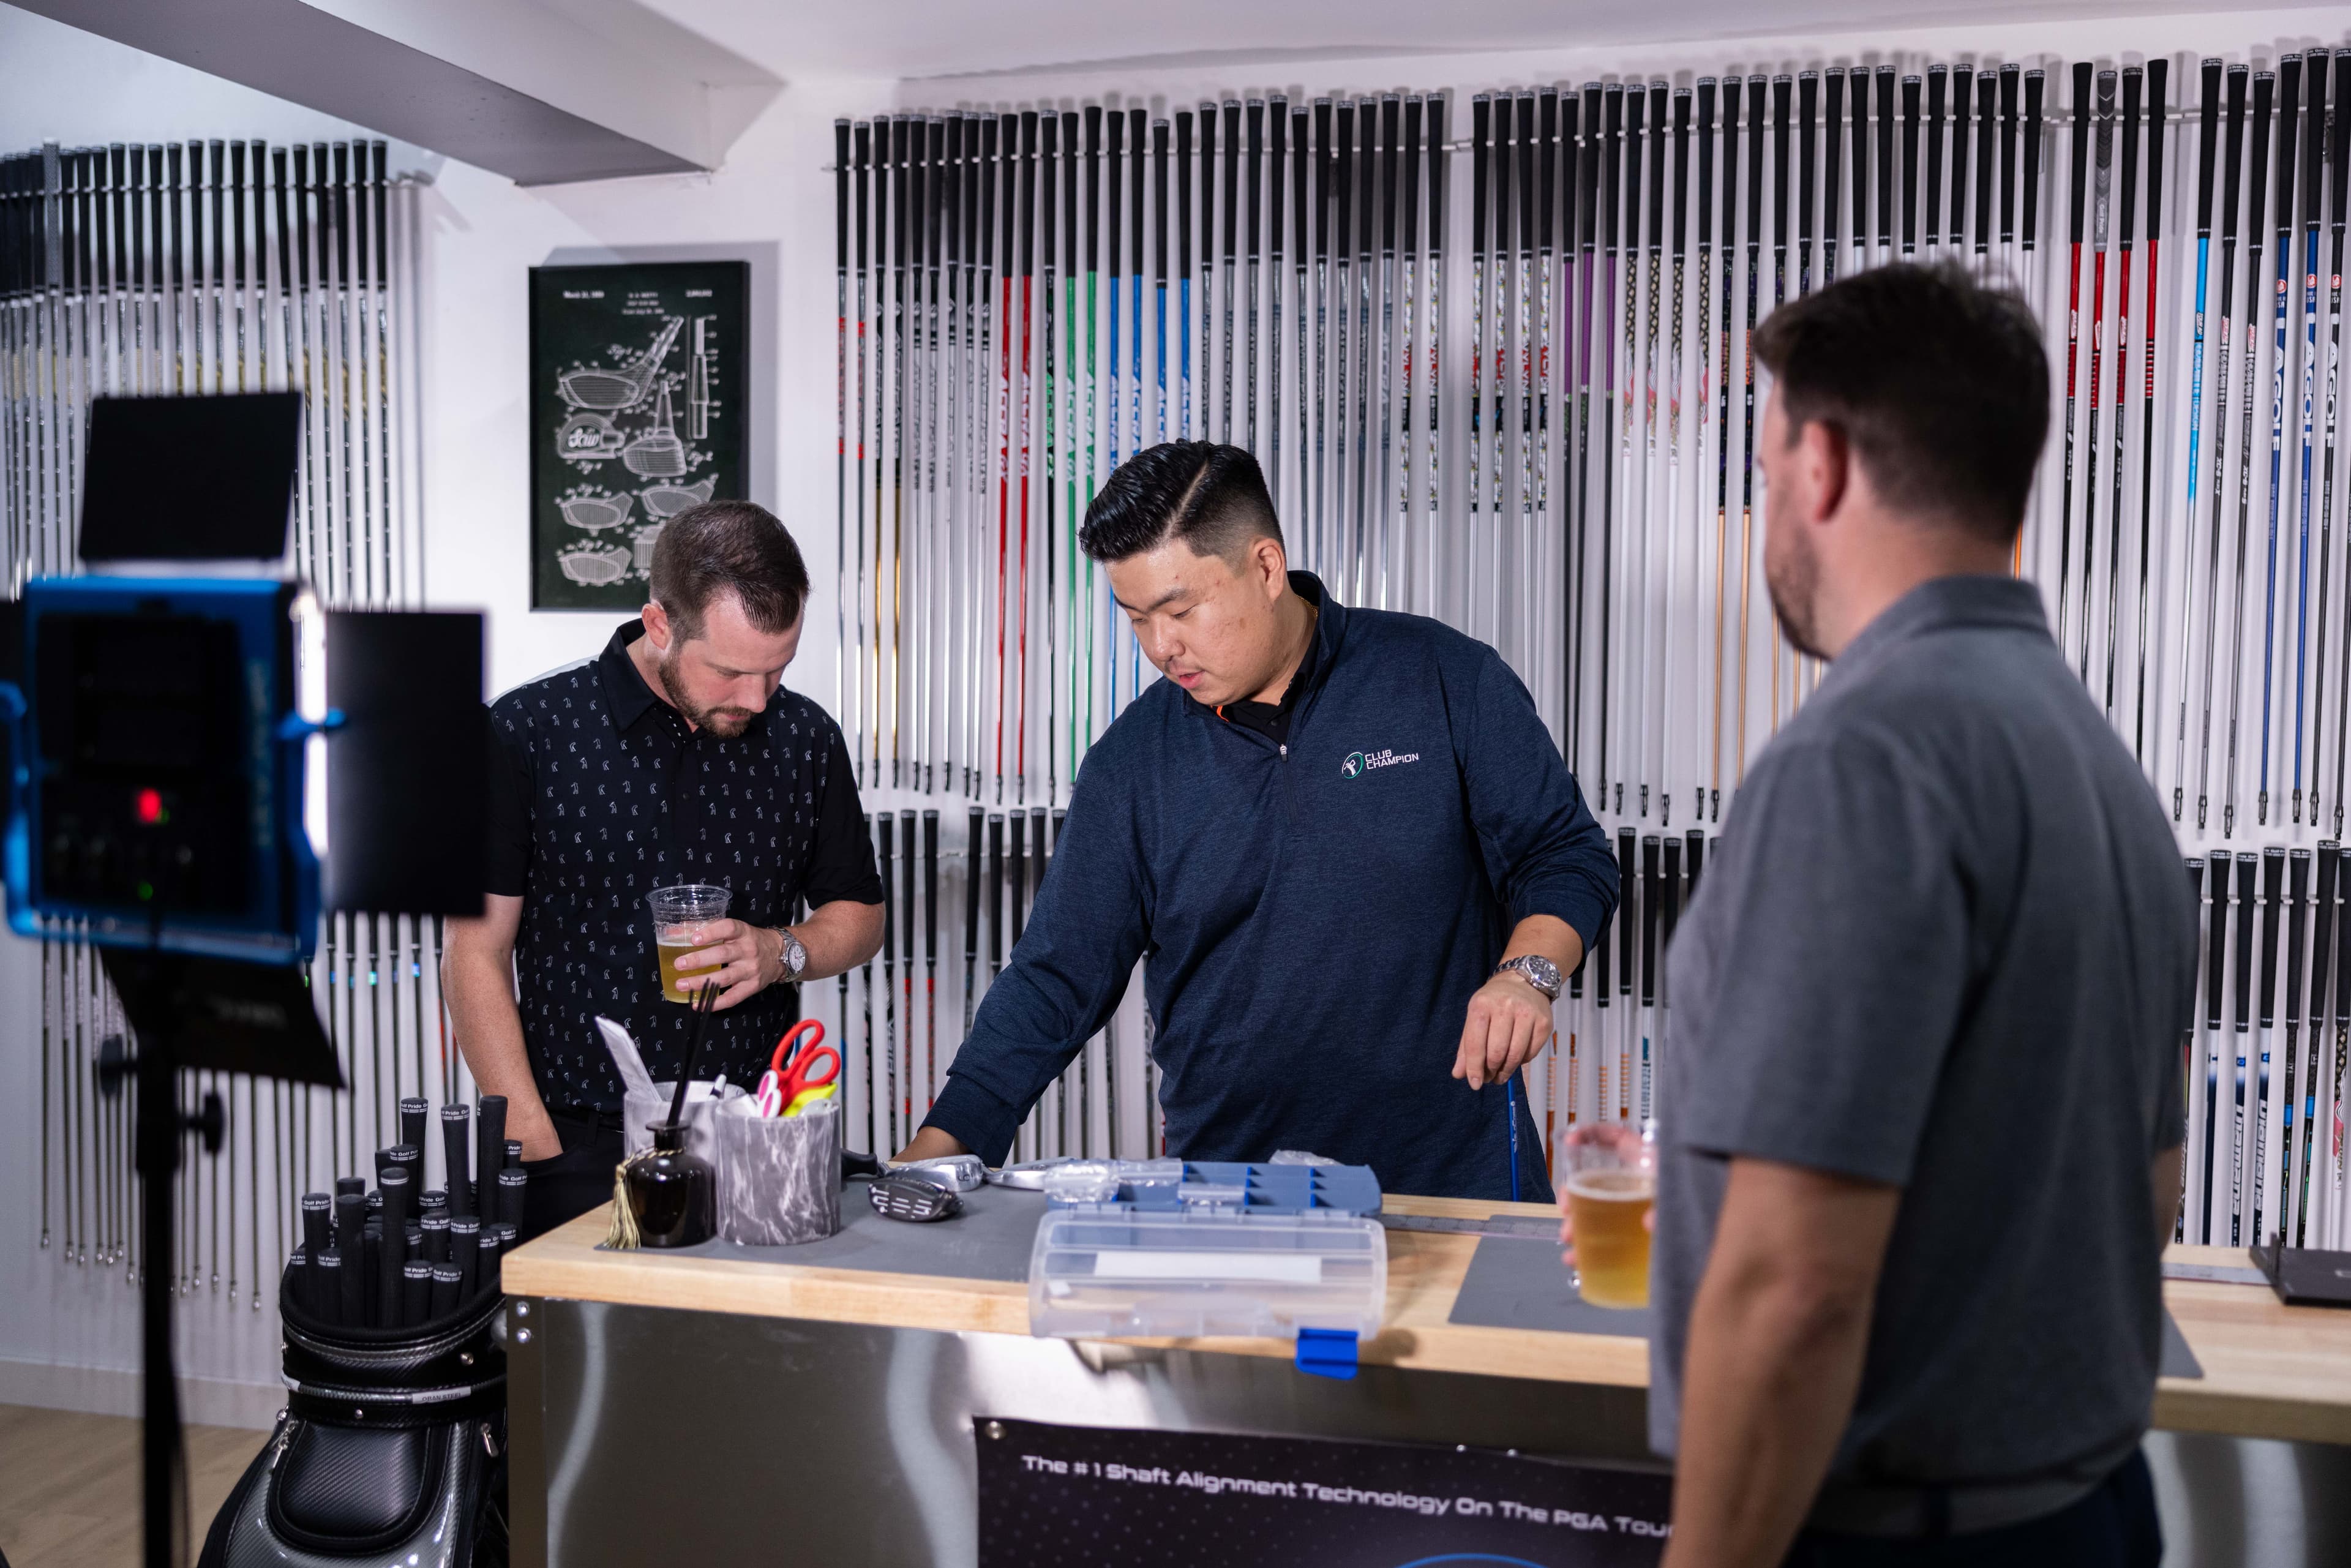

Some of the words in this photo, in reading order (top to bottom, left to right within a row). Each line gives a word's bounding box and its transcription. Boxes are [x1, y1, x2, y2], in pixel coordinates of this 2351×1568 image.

[1365, 749, 1392, 762] CLUB
[1366, 752, 1419, 770] CHAMPION
[2232, 1104, 2244, 1216] Diamana
[2254, 1099, 2268, 1212] Diamana
[1021, 1454, 1068, 1474] The
[1073, 1461, 1089, 1476] #
[1093, 1462, 1101, 1477] 1
[1105, 1463, 1171, 1485] Shaft
[1175, 1470, 1297, 1498] Alignment
[1302, 1482, 1450, 1515] Technology
[1455, 1496, 1493, 1517] On
[1498, 1500, 1548, 1523] The
[1553, 1509, 1609, 1531] PGA
